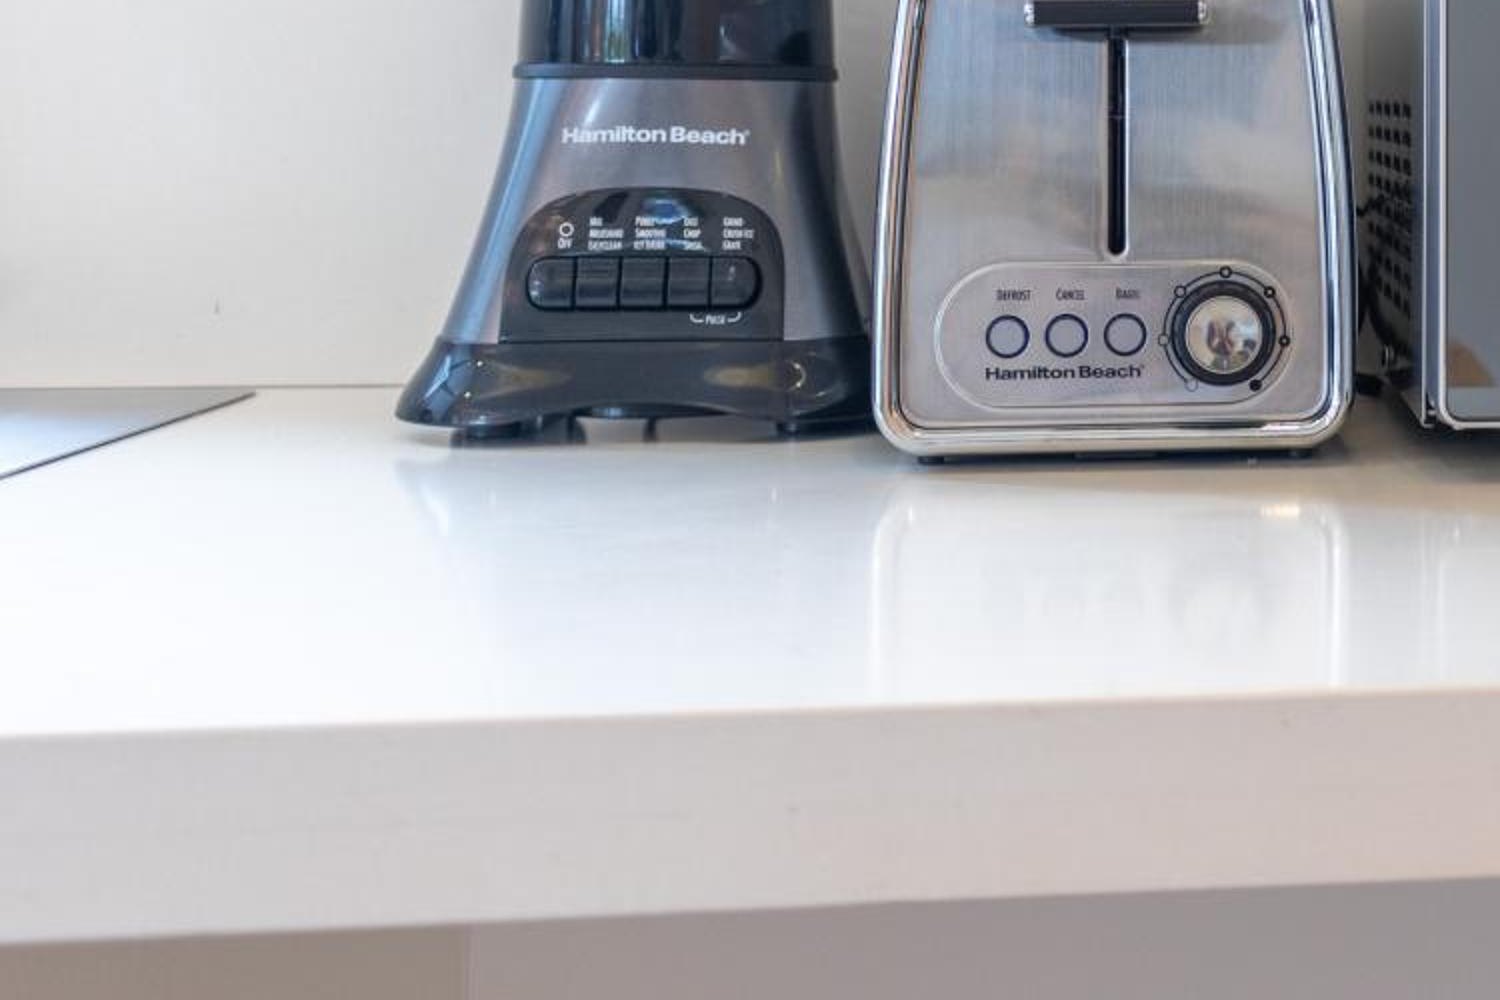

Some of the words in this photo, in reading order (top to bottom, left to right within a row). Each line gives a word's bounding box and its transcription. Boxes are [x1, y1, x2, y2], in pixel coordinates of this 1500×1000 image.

[561, 125, 667, 144] Hamilton
[670, 125, 746, 146] Beach
[985, 365, 1076, 381] Hamilton
[1078, 364, 1142, 380] Beach
